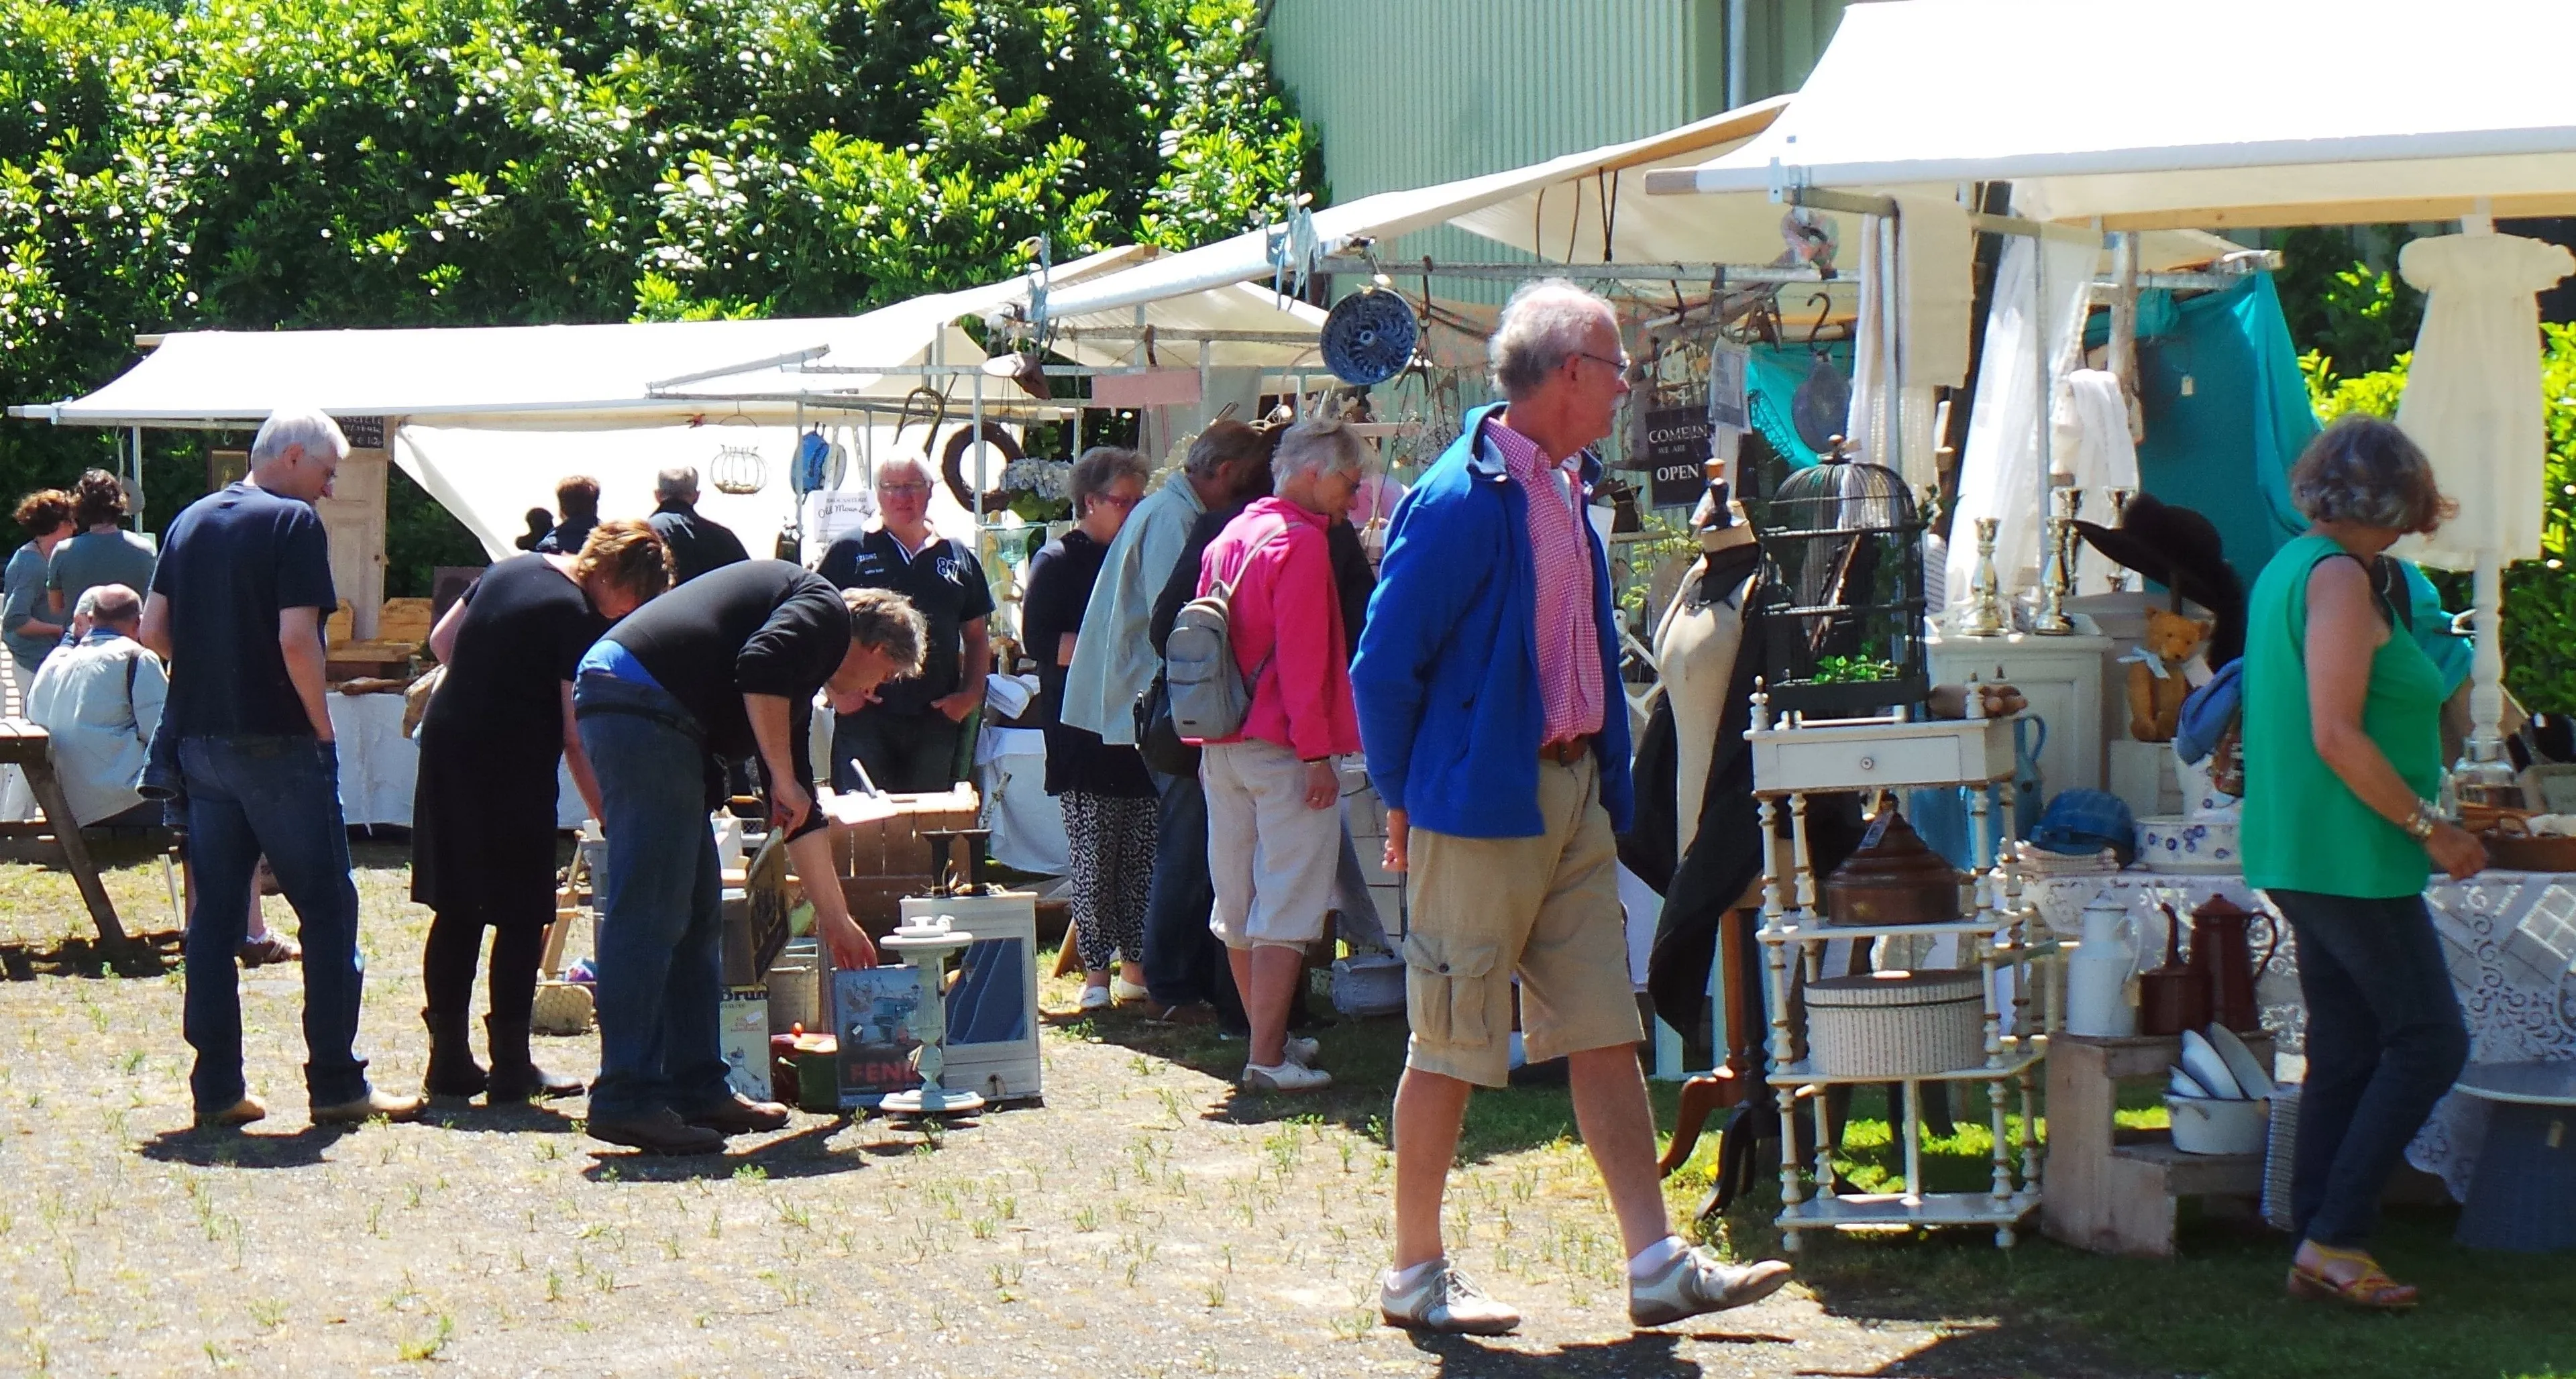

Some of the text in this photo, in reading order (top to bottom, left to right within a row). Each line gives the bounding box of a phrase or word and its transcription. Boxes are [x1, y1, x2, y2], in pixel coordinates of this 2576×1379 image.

[1649, 426, 1690, 443] COME
[1658, 444, 1686, 454] WE ARE
[1656, 463, 1699, 481] OPEN
[936, 557, 960, 581] 87
